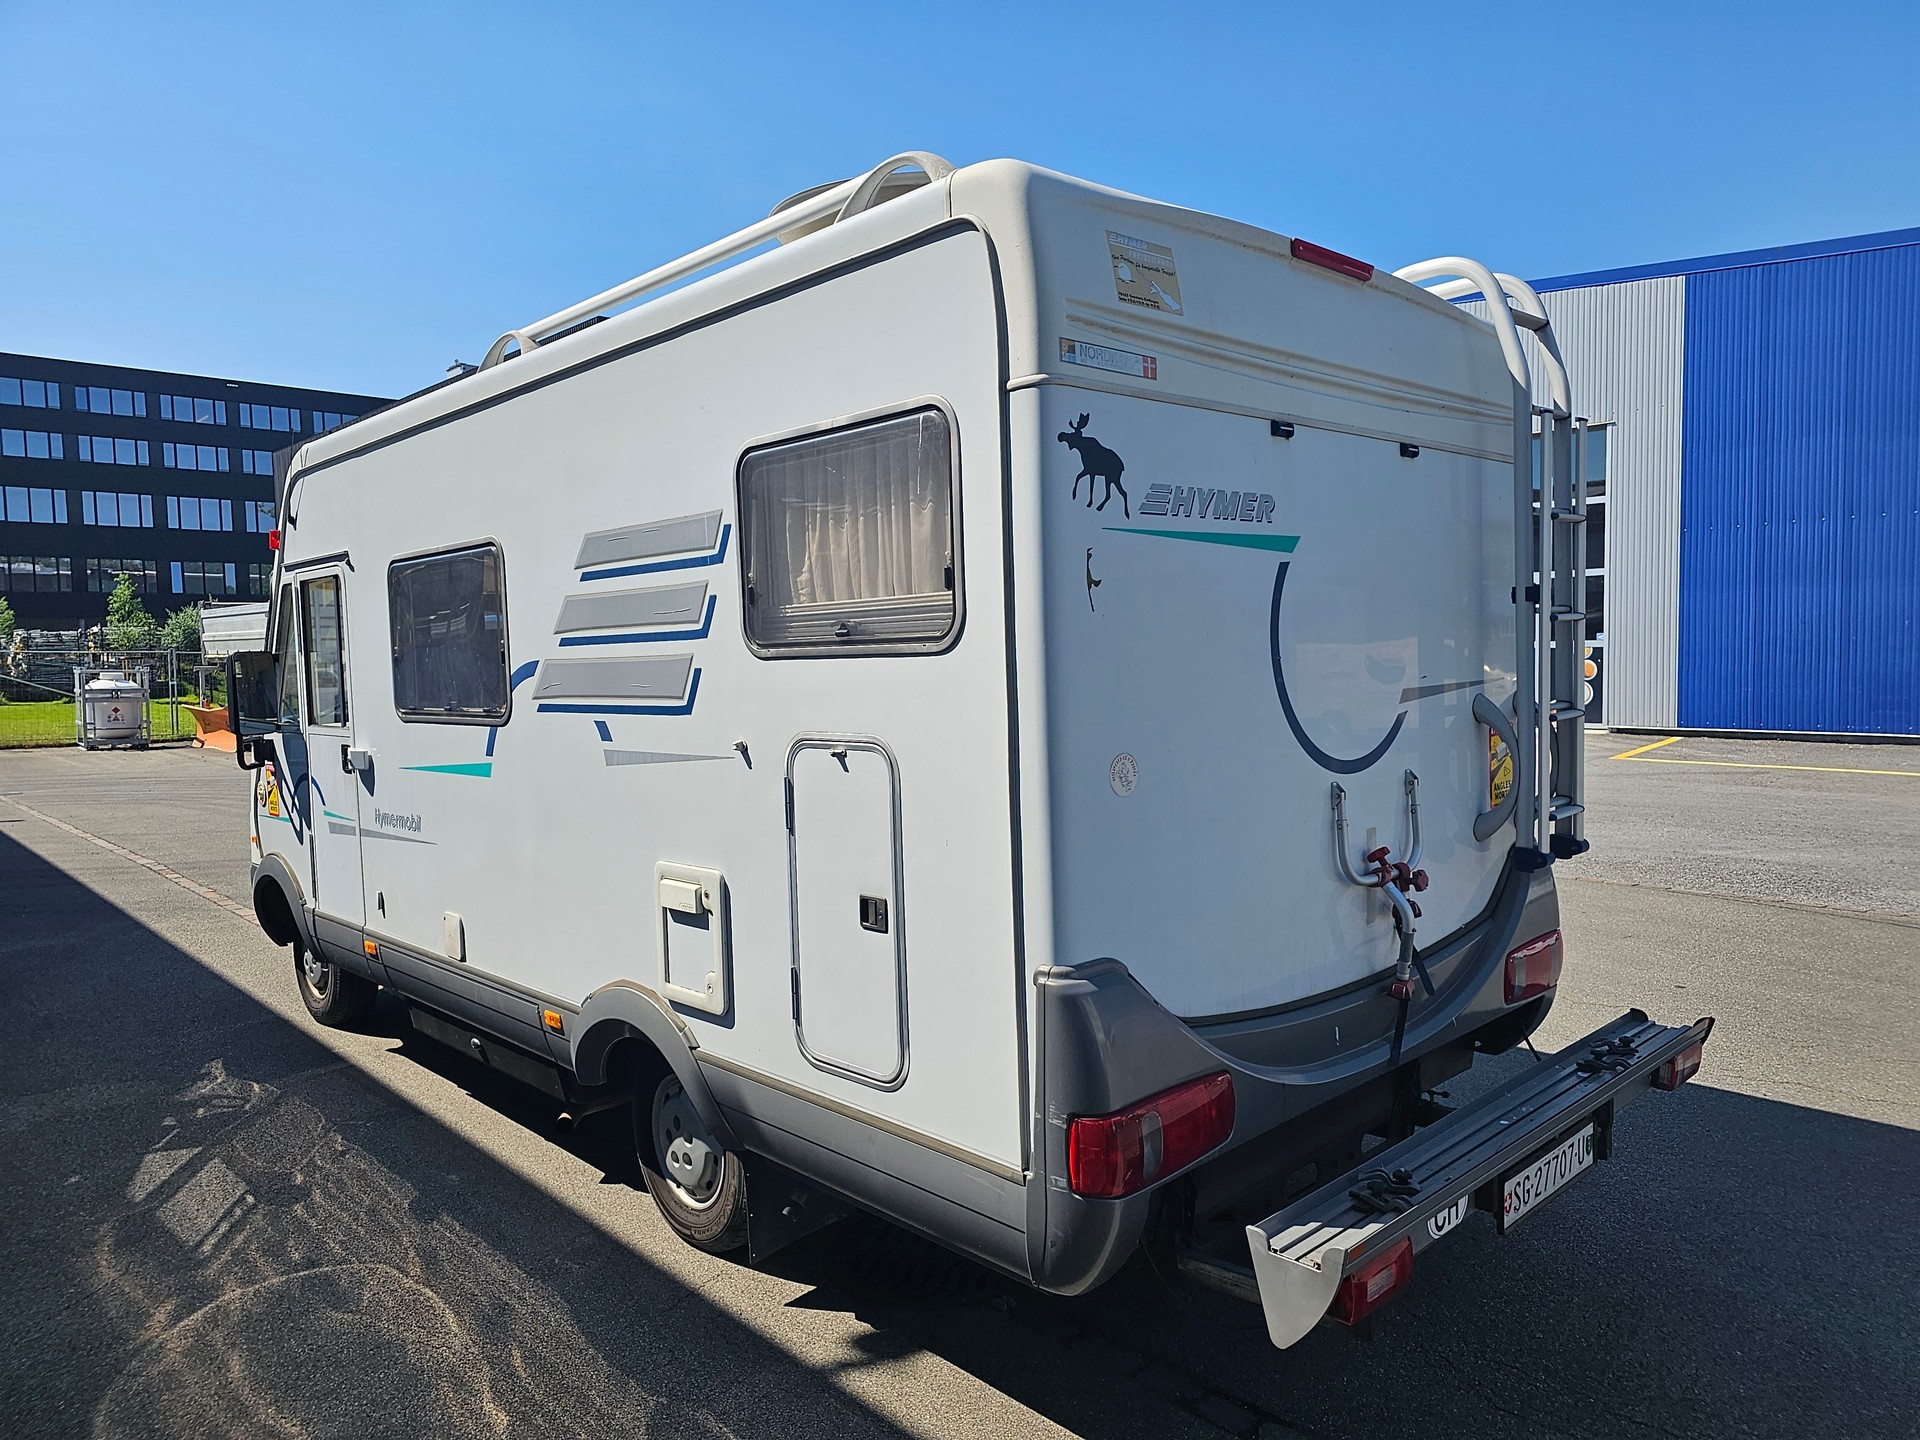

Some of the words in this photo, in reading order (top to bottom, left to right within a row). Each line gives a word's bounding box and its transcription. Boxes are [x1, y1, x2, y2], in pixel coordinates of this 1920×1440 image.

[1167, 485, 1276, 523] HYMER
[1494, 790, 1509, 801] MORT
[374, 807, 422, 833] Hymermobil
